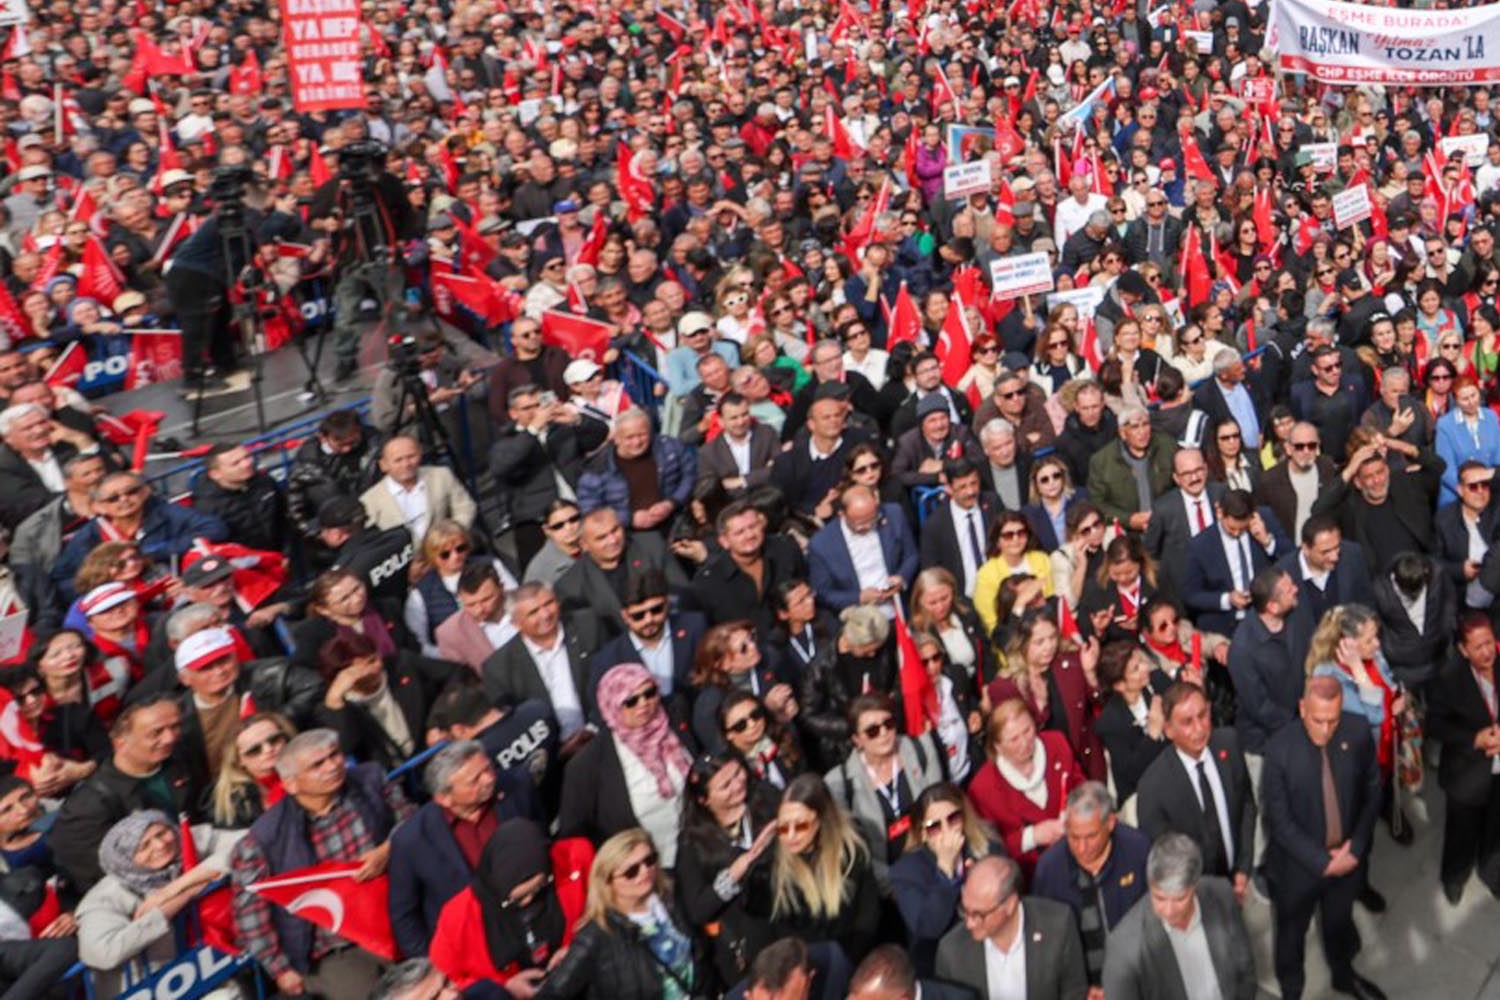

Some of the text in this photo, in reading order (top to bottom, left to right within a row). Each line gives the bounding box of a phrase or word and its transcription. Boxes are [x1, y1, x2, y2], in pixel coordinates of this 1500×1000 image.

[290, 20, 320, 40] YA
[1299, 25, 1361, 56] BAŞKAN
[1385, 46, 1460, 62] TOZAN
[1315, 65, 1343, 79] CHP
